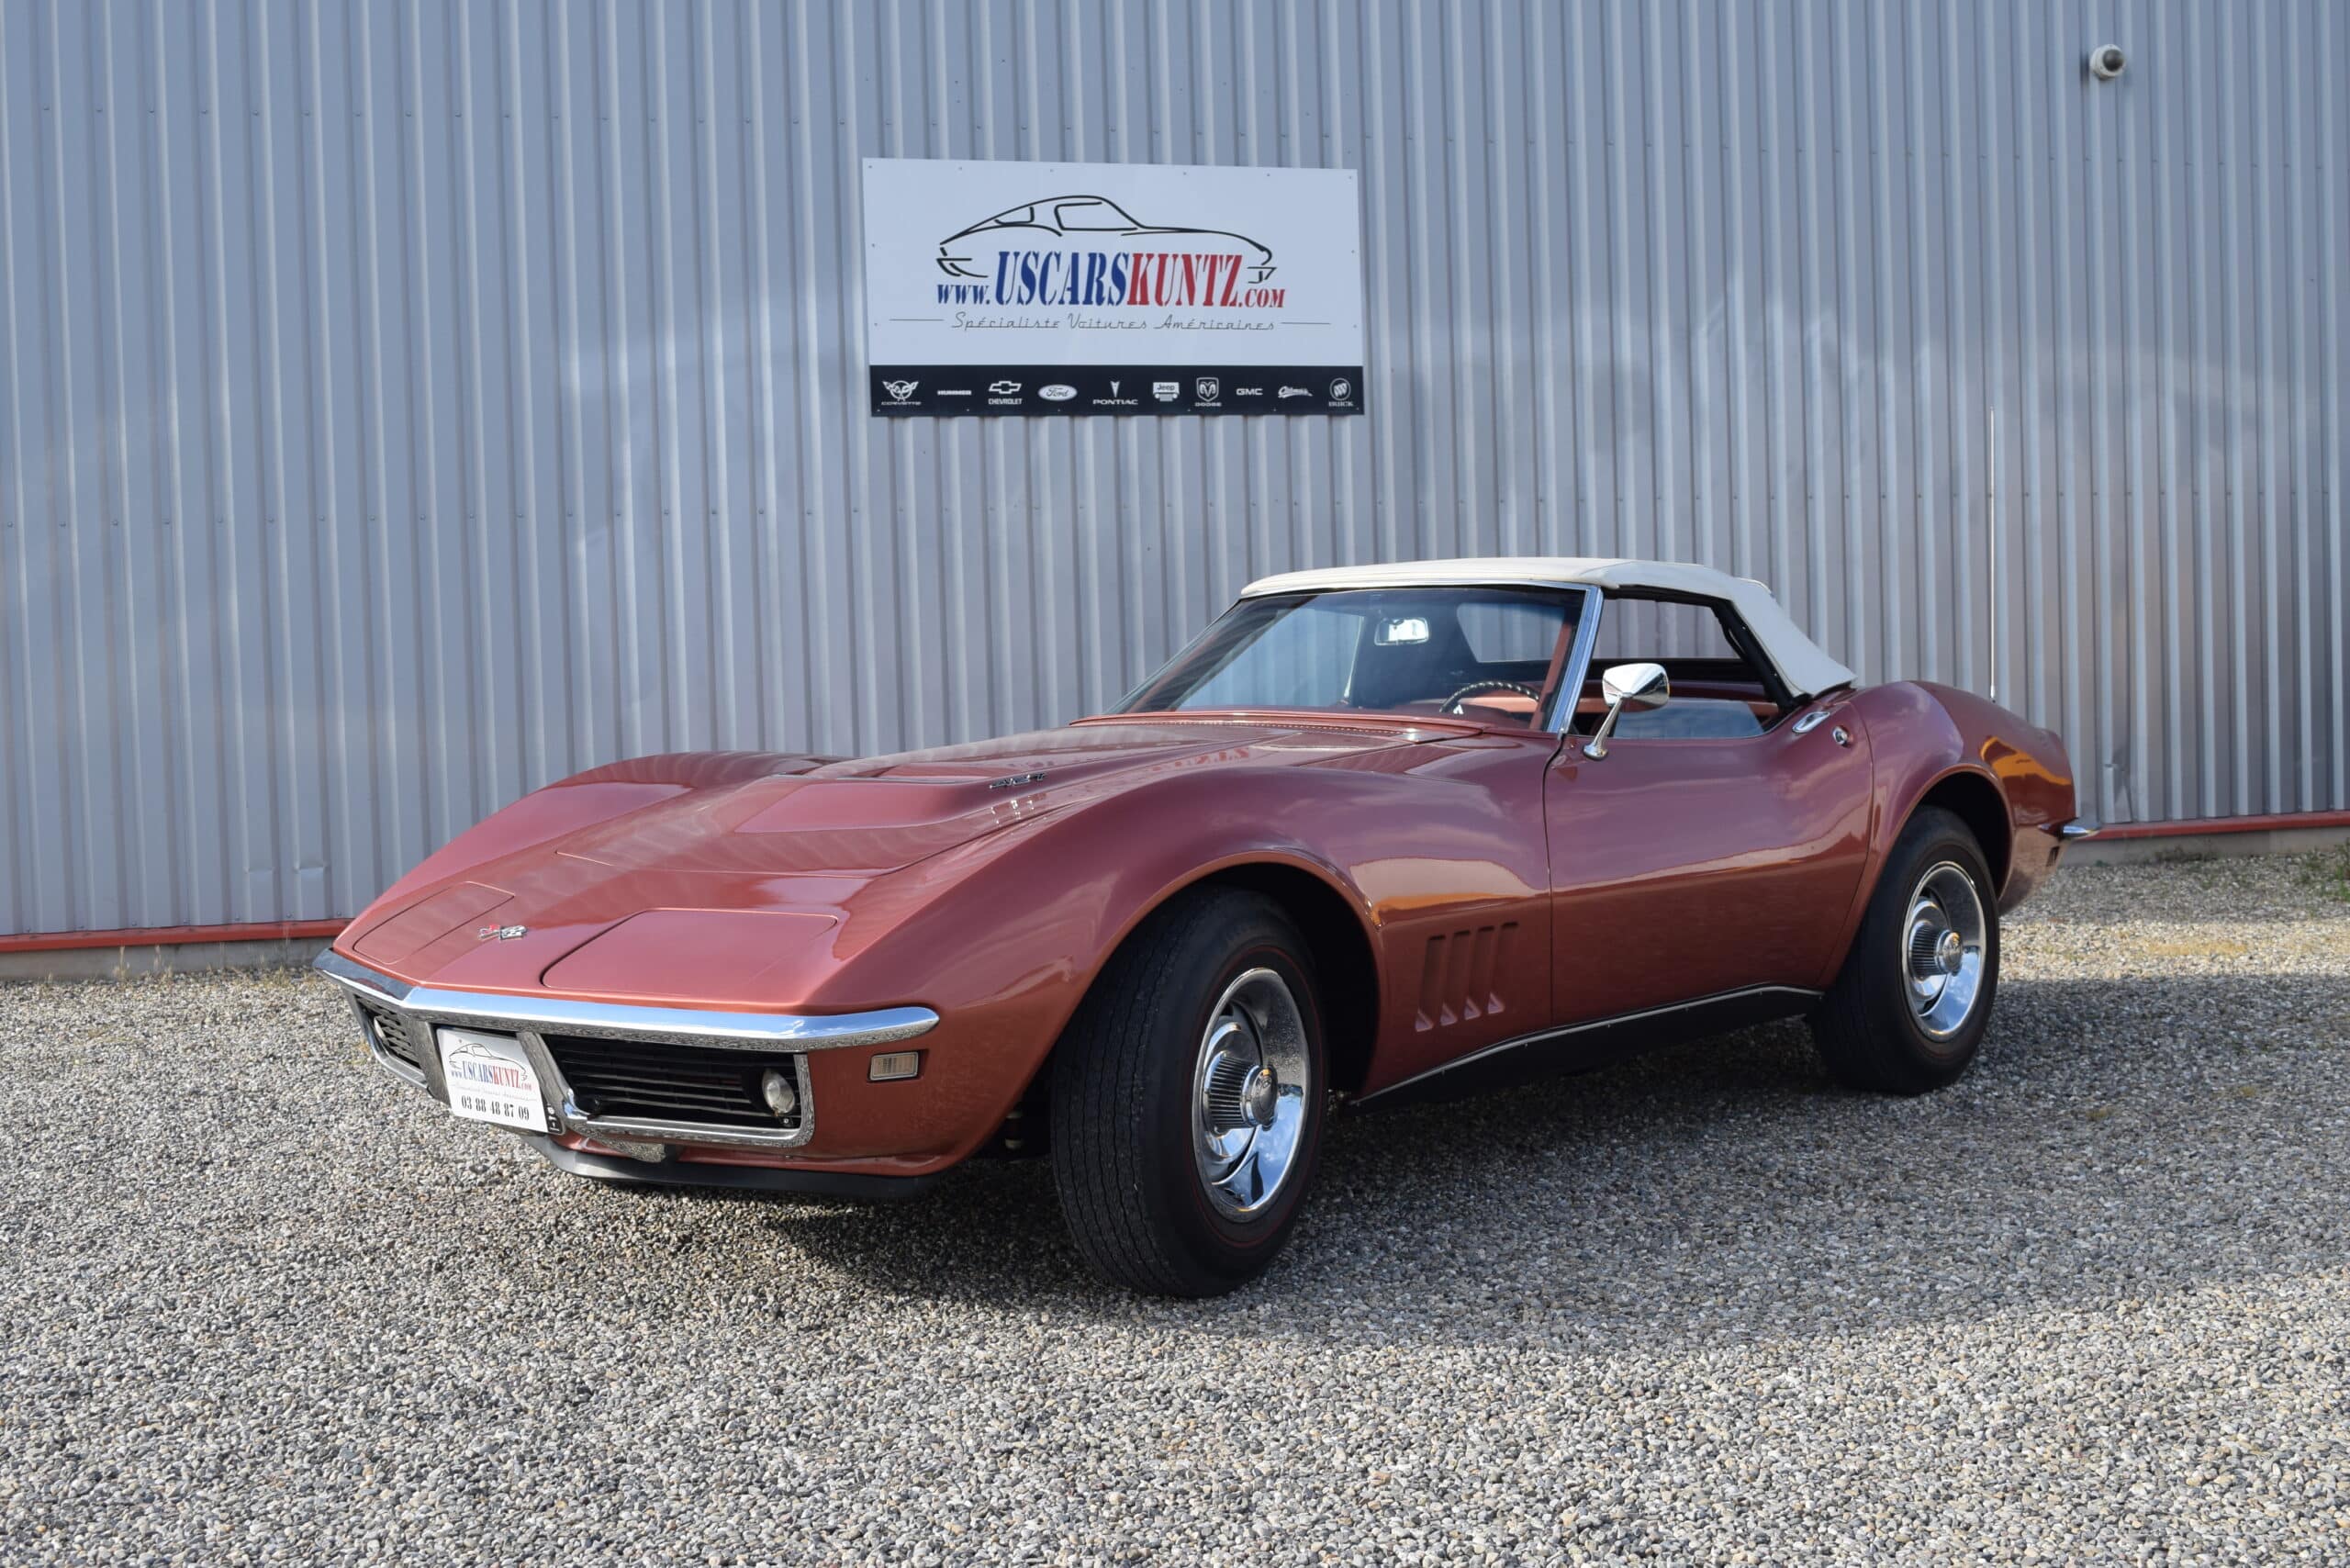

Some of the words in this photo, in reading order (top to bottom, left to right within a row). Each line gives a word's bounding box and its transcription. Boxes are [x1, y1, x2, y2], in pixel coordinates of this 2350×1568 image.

[952, 311, 1060, 331] Spécialiste
[1068, 312, 1147, 330] Voitures
[1153, 313, 1274, 330] Américaines
[1046, 386, 1069, 398] Ford
[1157, 384, 1175, 392] Jeep
[1236, 387, 1263, 396] GMC
[461, 1095, 473, 1110] 03
[476, 1098, 487, 1113] 88
[490, 1101, 501, 1115] 48
[504, 1103, 515, 1118] 87
[518, 1105, 530, 1121] 09
